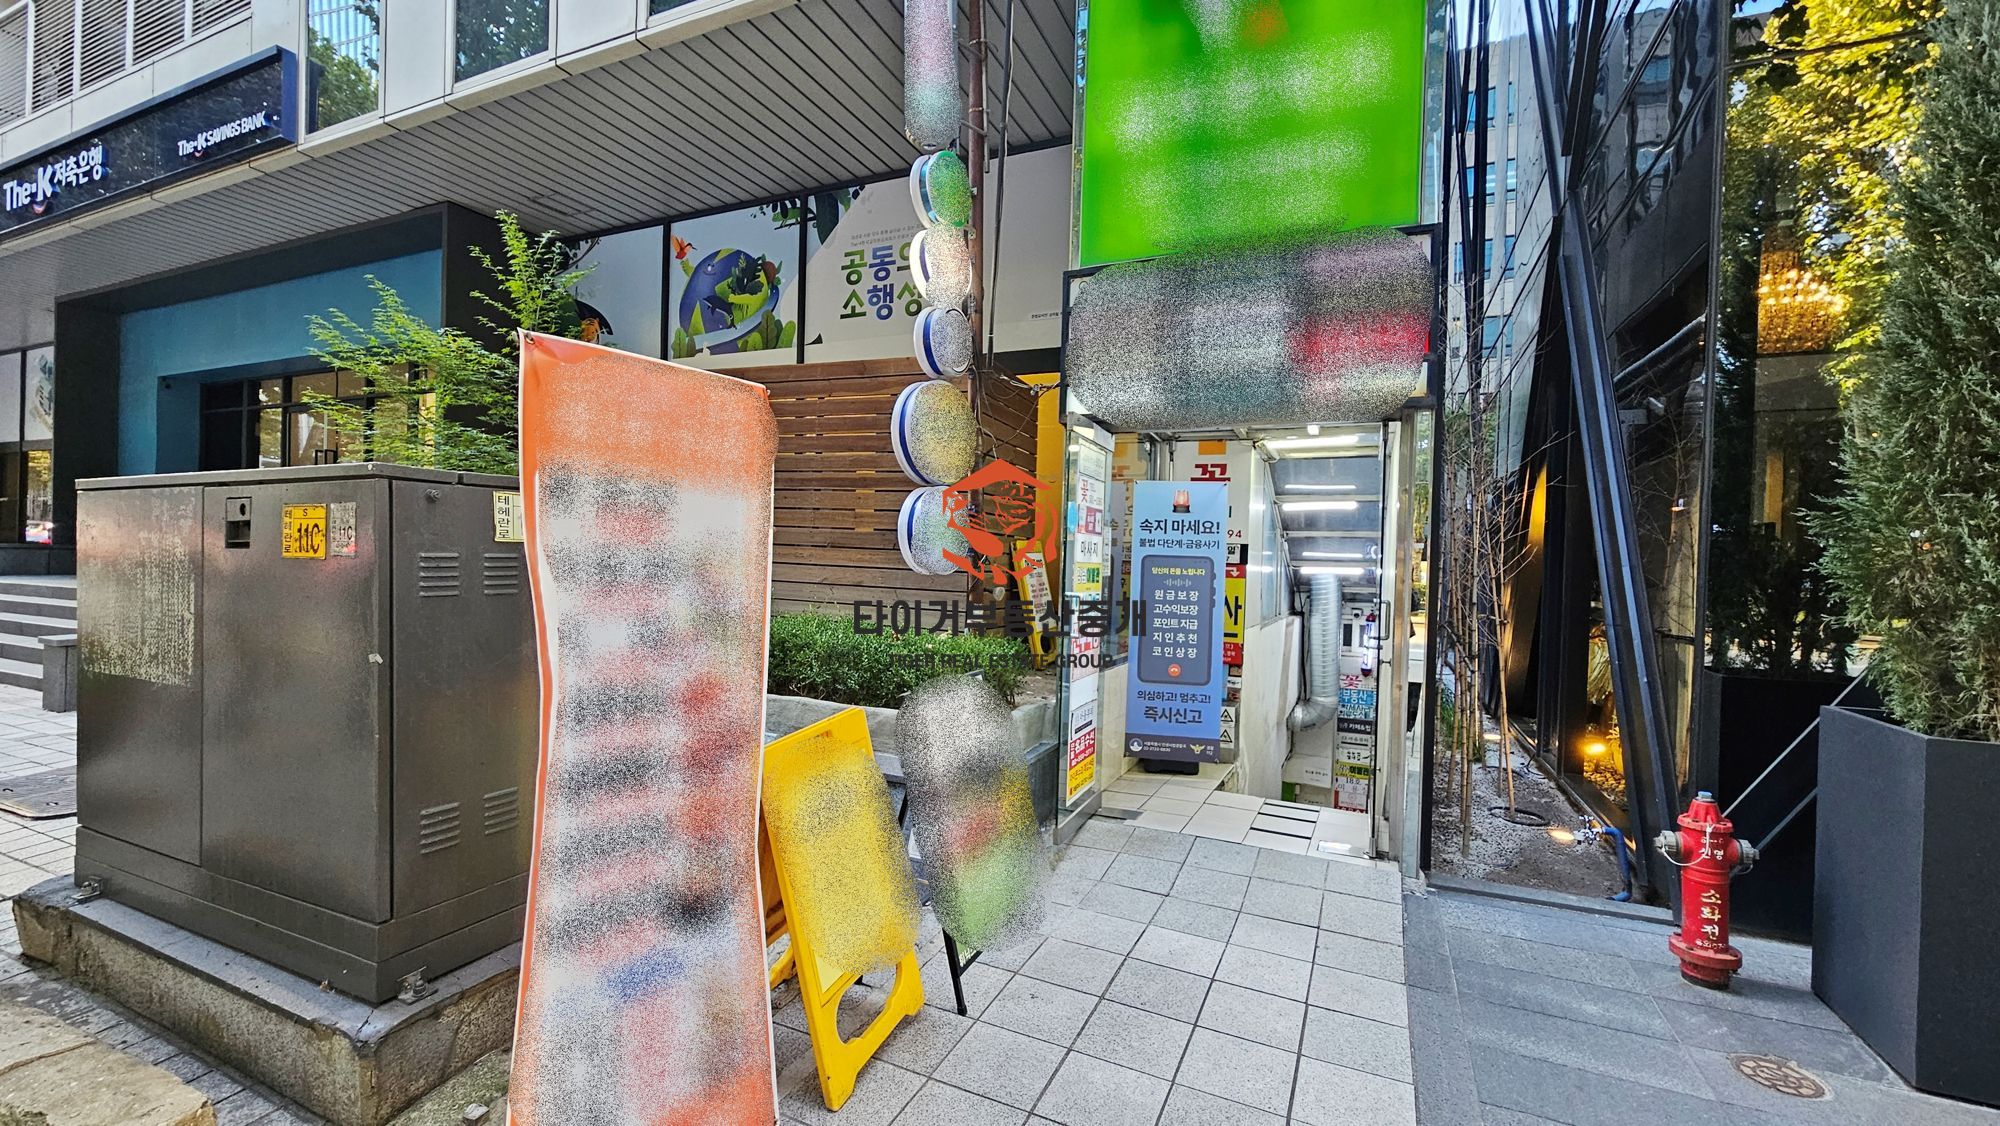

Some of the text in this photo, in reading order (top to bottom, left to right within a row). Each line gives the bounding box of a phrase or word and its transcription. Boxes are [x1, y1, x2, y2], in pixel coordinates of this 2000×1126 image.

[206, 120, 241, 146] SAVINGS
[241, 111, 266, 133] BANK
[54, 145, 103, 187] 저축은행
[840, 281, 923, 320] 소행성
[497, 495, 511, 539] 테헤란로
[1140, 519, 1220, 535] 속지 마세요!
[1140, 538, 1156, 548] 불법
[1151, 567, 1169, 575] 당신의
[1153, 603, 1199, 616] 고수익보장
[1137, 690, 1211, 704] 의심하고! 멈추고!
[1343, 689, 1368, 704] 부동산
[1143, 706, 1203, 724] 즉시신고
